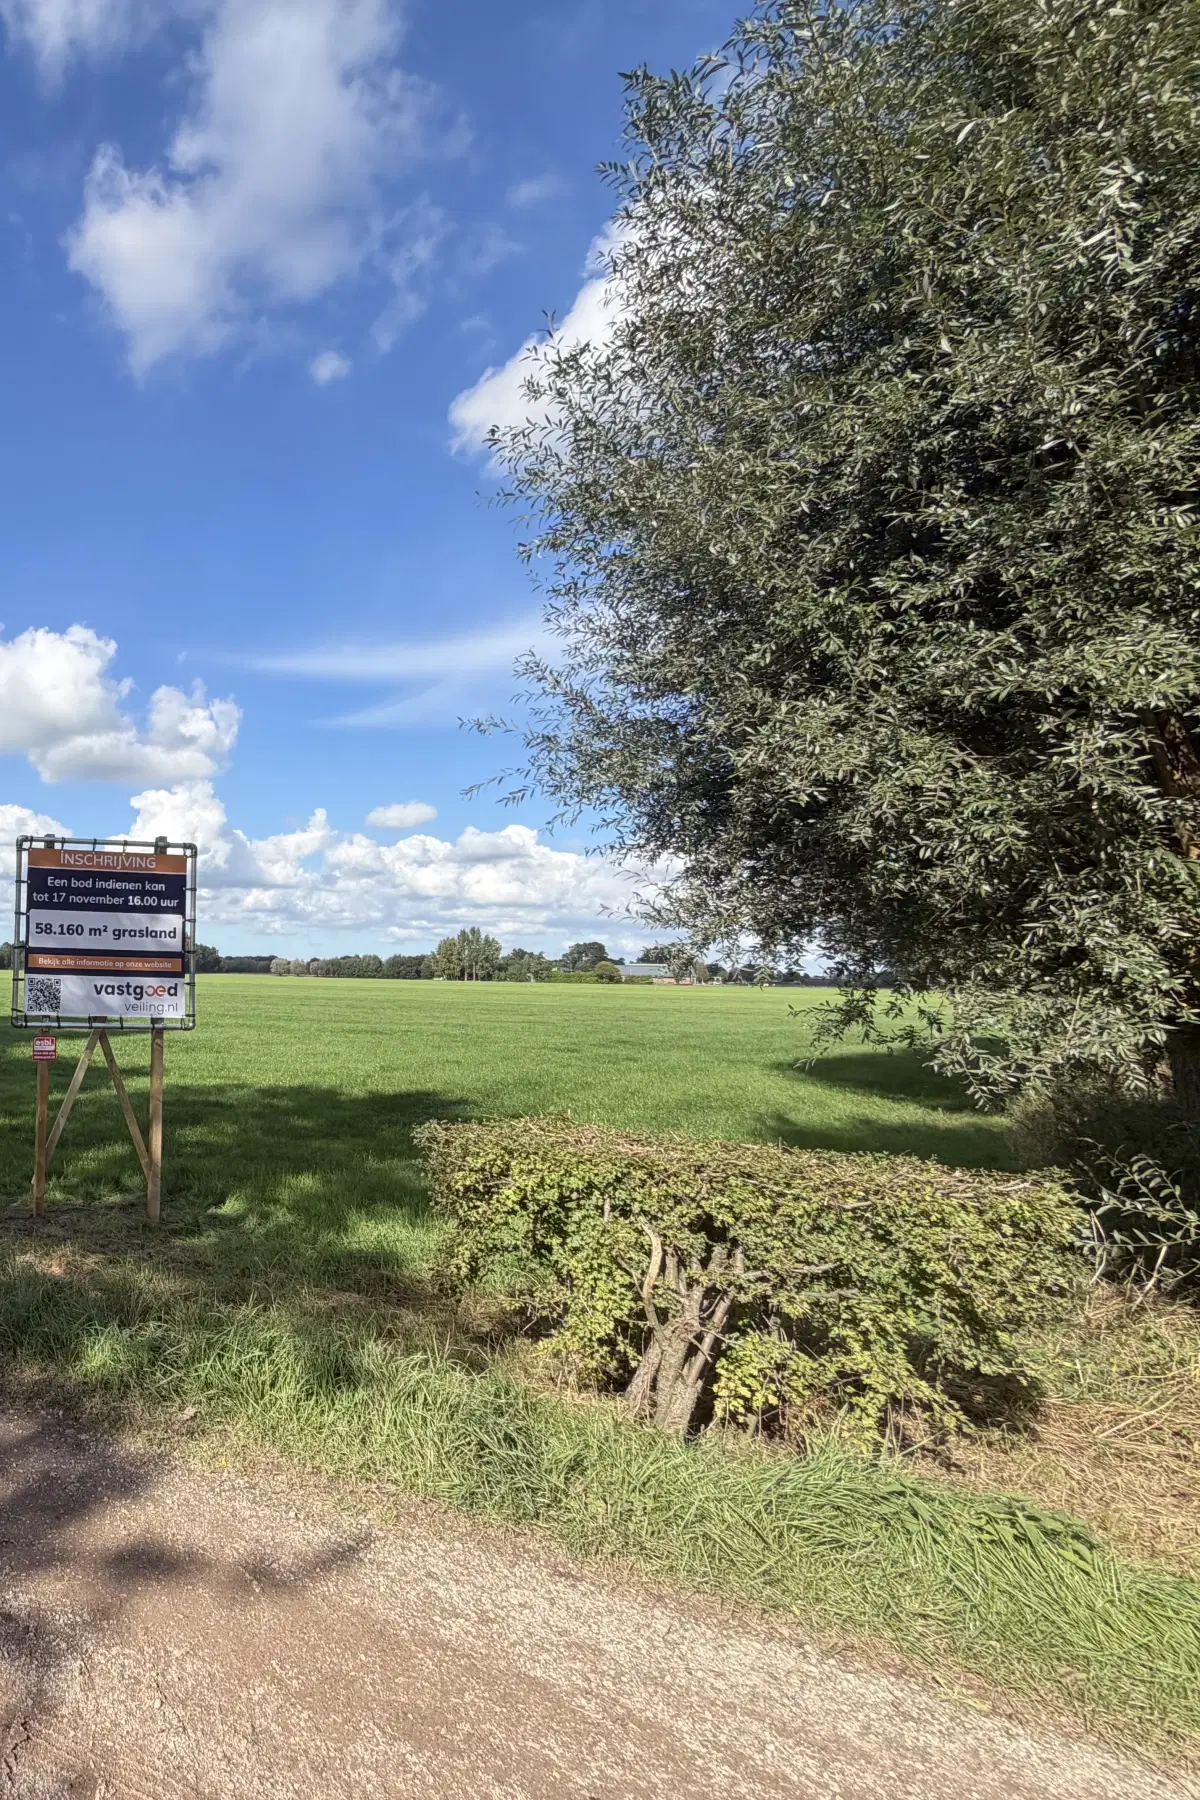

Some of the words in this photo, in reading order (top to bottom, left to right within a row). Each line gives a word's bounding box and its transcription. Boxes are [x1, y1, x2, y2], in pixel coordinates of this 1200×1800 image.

[60, 853, 156, 869] INSCHRIJVING
[47, 877, 67, 887] Een
[71, 878, 93, 888] bod
[96, 879, 142, 890] indienen
[145, 880, 165, 891] kan
[33, 893, 49, 902] tot
[53, 893, 65, 902] 17
[69, 894, 124, 904] november
[128, 896, 157, 906] 16.00
[161, 898, 179, 907] uur
[35, 923, 84, 936] 58.160
[89, 925, 108, 937] m²
[113, 928, 176, 940] grasland
[94, 982, 178, 1000] vastgoed
[124, 1002, 178, 1014] veiling.nl
